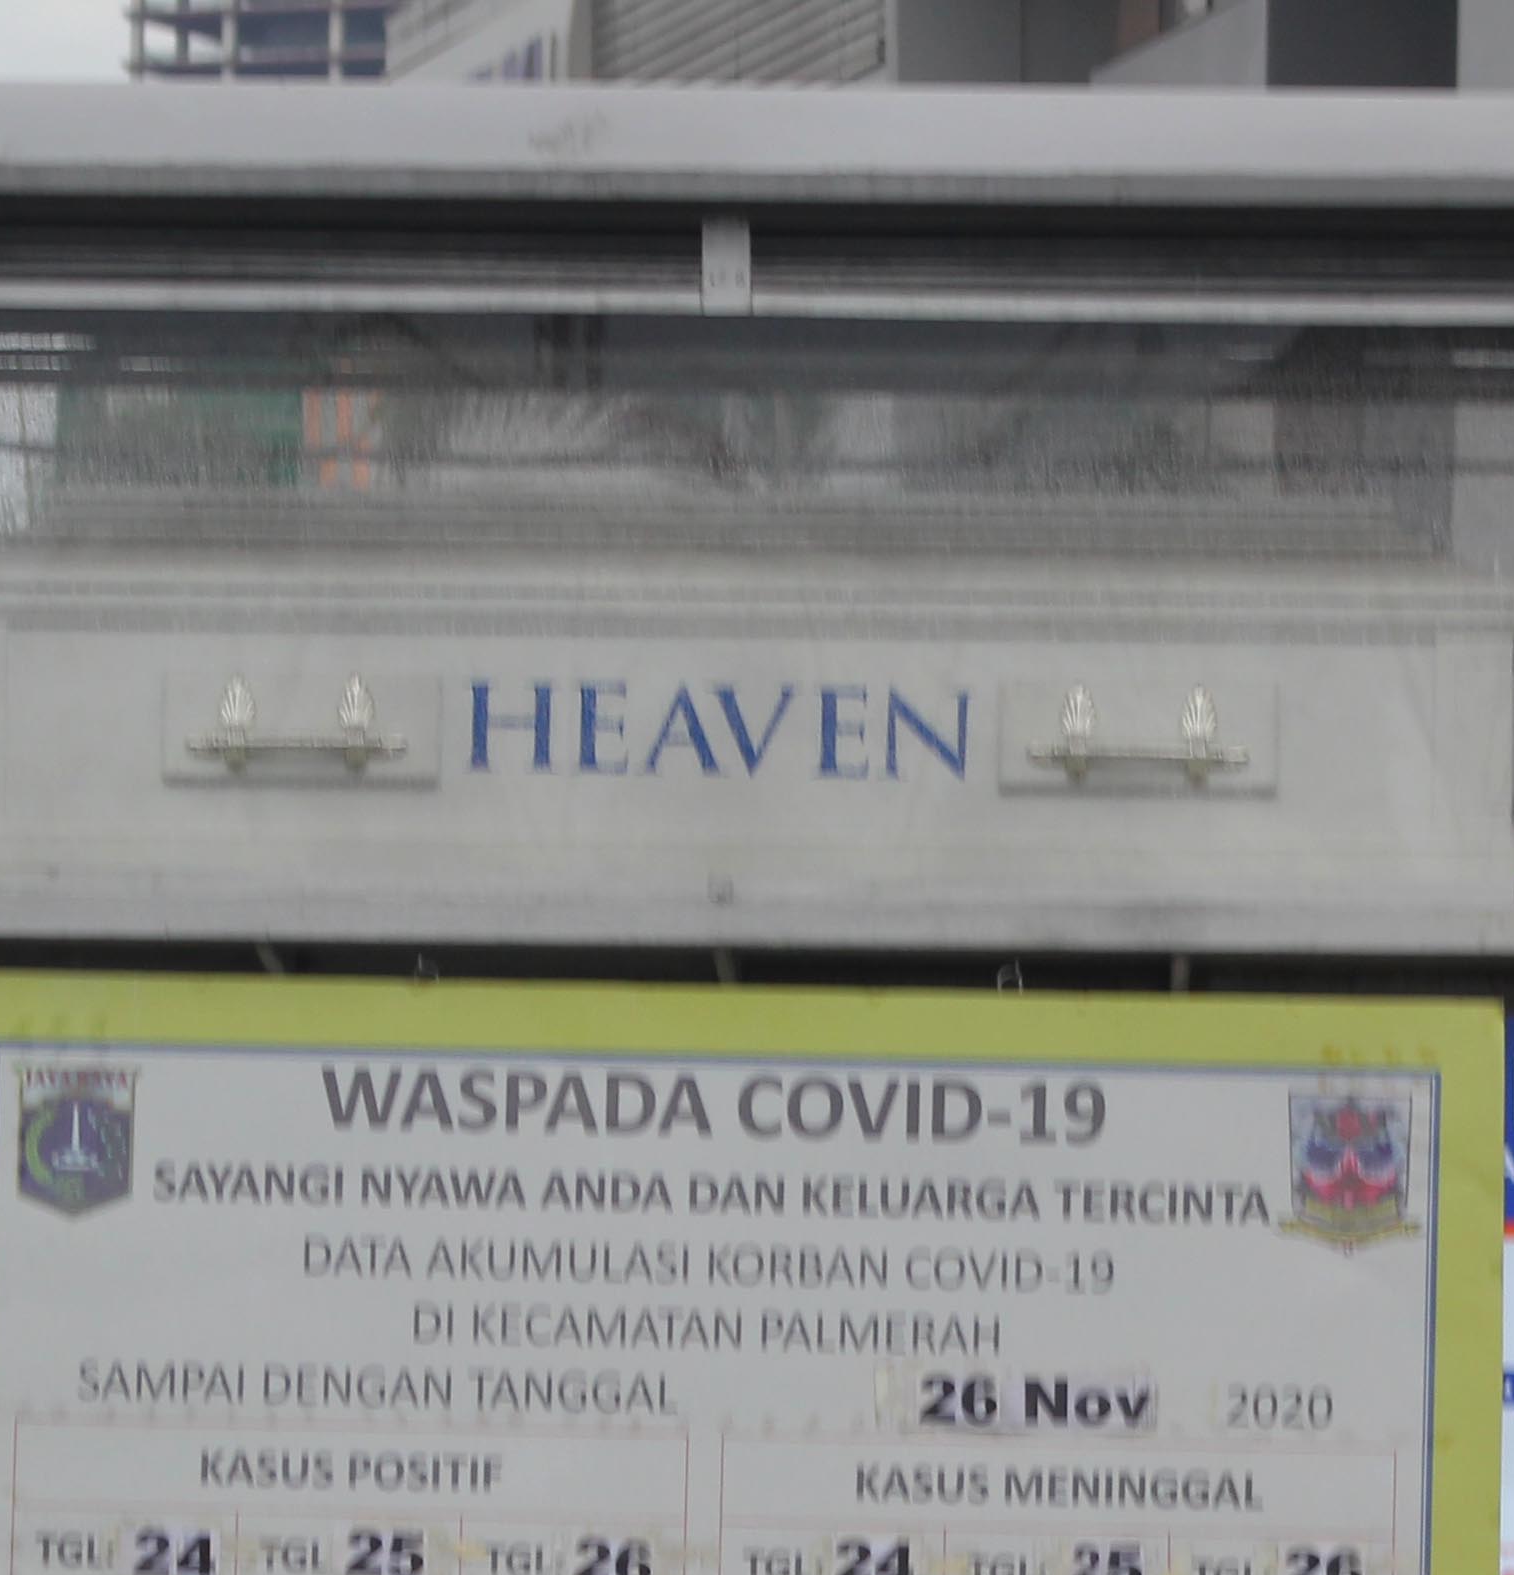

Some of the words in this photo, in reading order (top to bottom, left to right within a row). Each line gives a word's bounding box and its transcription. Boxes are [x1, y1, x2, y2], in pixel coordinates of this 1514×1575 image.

[465, 680, 971, 780] HEAVEN
[322, 1064, 713, 1140] WASPADA
[736, 1075, 1107, 1149] COVID-19
[152, 1158, 345, 1206] SAYANGI
[361, 1165, 525, 1211] NYAWA
[541, 1169, 674, 1216] ANDA
[689, 1173, 786, 1219] DAN
[803, 1176, 1040, 1224] KELUARGA
[1055, 1180, 1272, 1228] TERCINTA
[303, 1234, 412, 1281] DATA
[427, 1238, 689, 1287] AKUMULASI
[708, 1243, 888, 1291] KORBAN
[905, 1247, 1116, 1296] COVID-19
[413, 1303, 454, 1346] DI
[472, 1305, 743, 1352] KECAMATAN
[761, 1311, 1001, 1358] PALMERAH
[79, 1357, 245, 1403] SAMPAI
[263, 1361, 453, 1409] DENGAN
[468, 1367, 678, 1416] TANGGAL
[917, 1373, 998, 1427] 26
[1023, 1376, 1150, 1430] Nov
[1225, 1384, 1334, 1432] 2020
[199, 1446, 334, 1491] KASUS
[348, 1449, 503, 1494] POSITIF
[856, 1460, 990, 1506] KASUS
[1005, 1464, 1263, 1512] MENINGGAL
